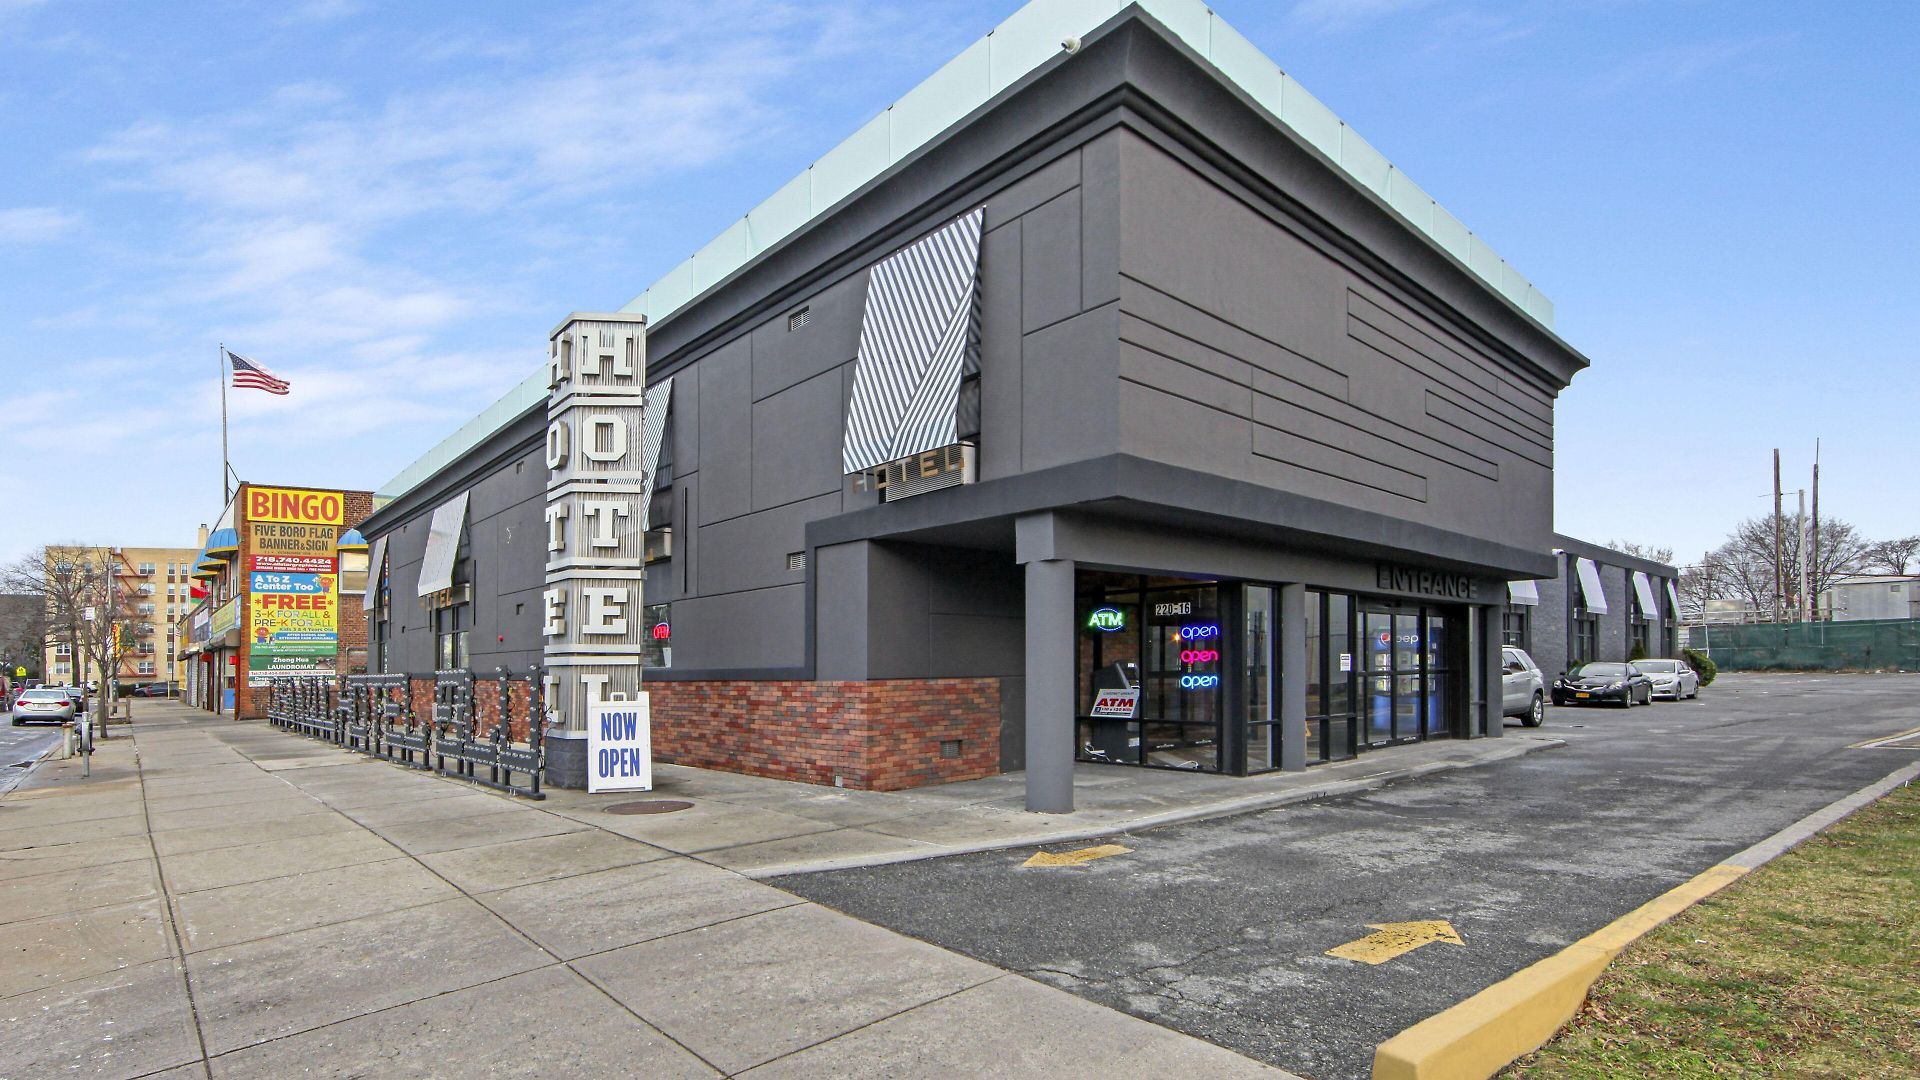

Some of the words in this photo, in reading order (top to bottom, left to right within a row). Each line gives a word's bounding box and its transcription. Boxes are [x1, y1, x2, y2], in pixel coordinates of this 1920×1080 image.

[252, 492, 340, 521] BINGO
[255, 525, 276, 537] FIVE
[280, 526, 306, 538] BORO
[310, 528, 333, 539] FLAG
[256, 556, 332, 565] 718.740.4424
[255, 582, 292, 590] Center
[267, 575, 279, 583] To
[1377, 567, 1478, 600] ENTRANCE
[255, 610, 275, 618] 3-K
[277, 610, 300, 618] FOR
[323, 611, 331, 619] &
[1156, 602, 1191, 616] 220-16
[255, 619, 288, 627] PRE-K
[291, 619, 313, 627] FOR
[1088, 611, 1123, 627] ATM
[1181, 625, 1218, 640] open
[1181, 650, 1218, 664] open
[1181, 675, 1218, 690] open
[1096, 698, 1134, 707] ATM
[601, 712, 637, 741] NOW
[599, 747, 640, 778] OPEN
